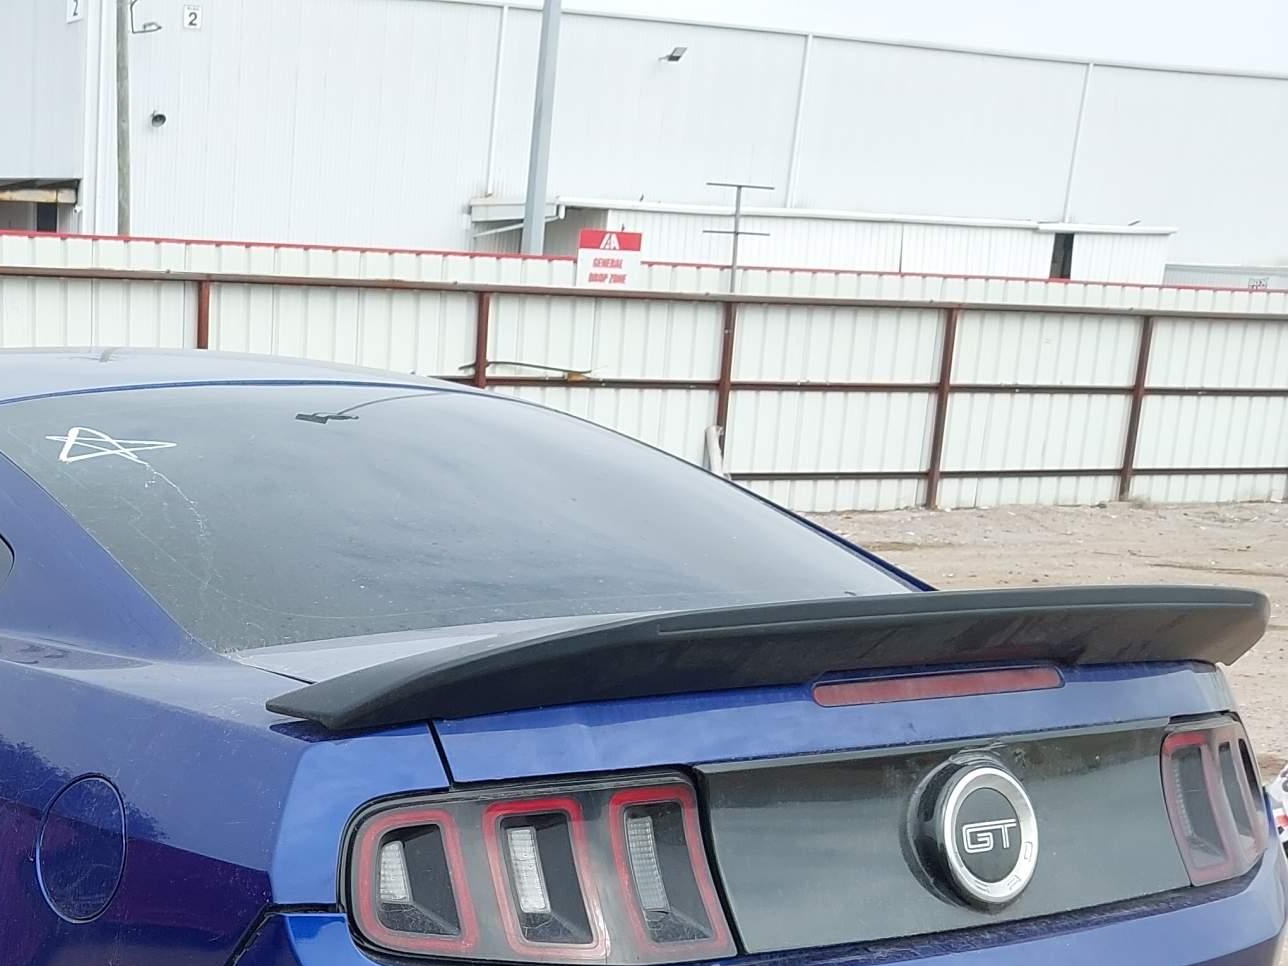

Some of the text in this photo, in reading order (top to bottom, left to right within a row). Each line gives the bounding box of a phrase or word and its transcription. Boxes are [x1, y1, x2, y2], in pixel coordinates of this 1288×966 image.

[187, 12, 198, 26] 2
[592, 257, 623, 269] GENERAL
[962, 818, 1017, 854] GT
